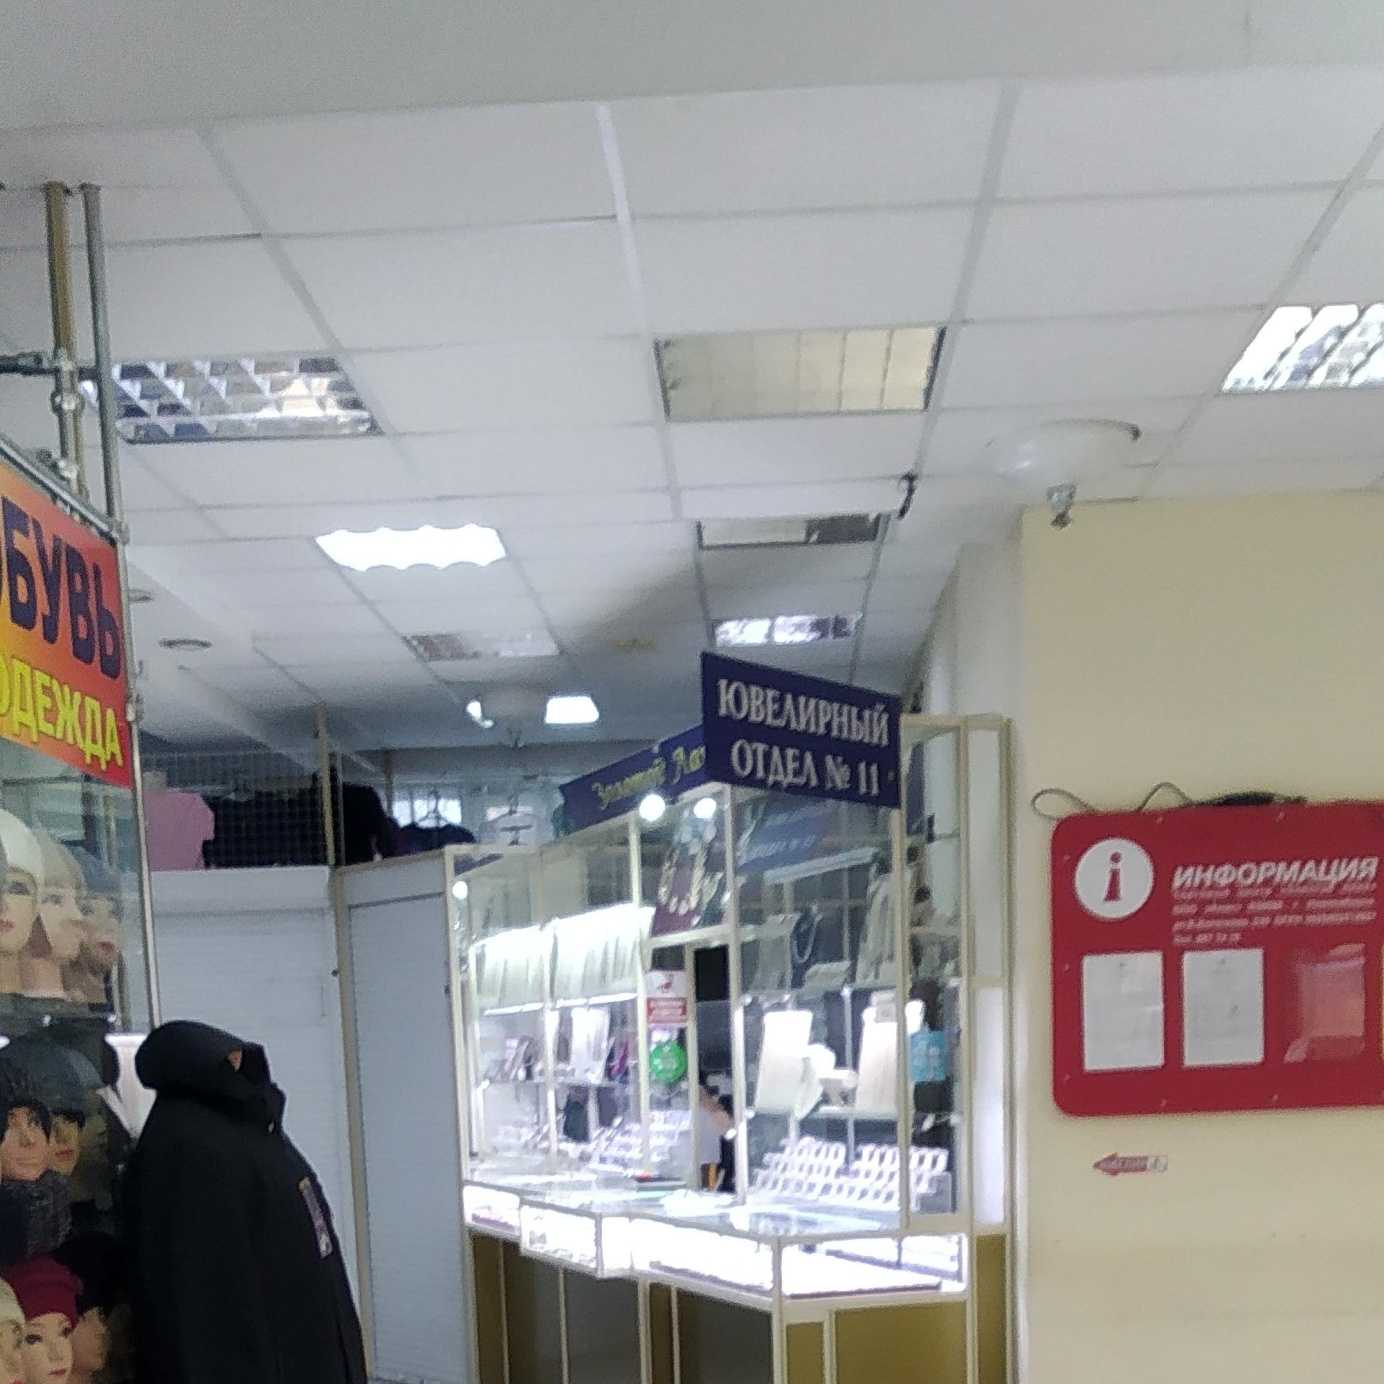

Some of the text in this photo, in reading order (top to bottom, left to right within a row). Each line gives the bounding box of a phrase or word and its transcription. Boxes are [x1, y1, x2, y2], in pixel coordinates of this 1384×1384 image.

[0, 496, 120, 680] БУВЬ
[717, 678, 889, 747] ЮВЕЛИРНЫЙ
[731, 739, 880, 796] ОТДЕЛ № 11
[1172, 856, 1379, 889] ИНФОРМАЦИЯ
